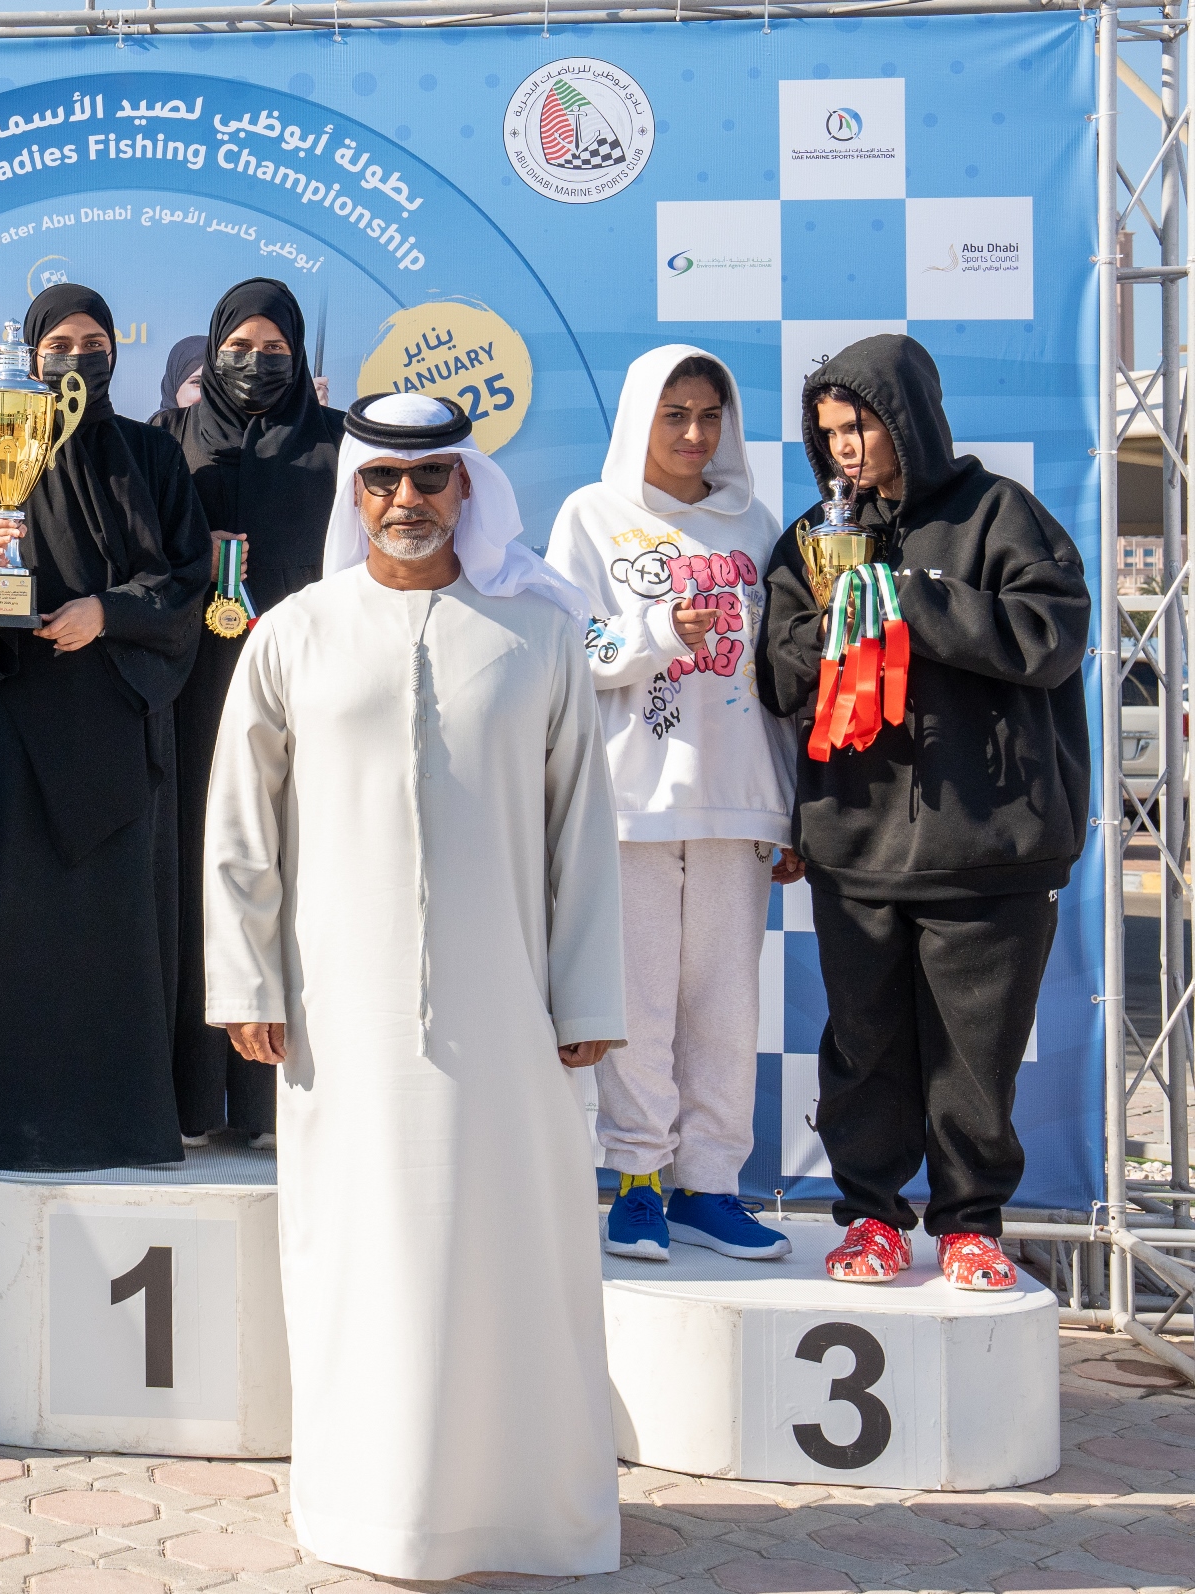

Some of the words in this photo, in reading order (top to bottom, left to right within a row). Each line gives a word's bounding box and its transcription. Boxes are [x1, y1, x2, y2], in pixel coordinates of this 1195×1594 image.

[540, 65, 592, 83] للرياضات
[592, 71, 631, 91] أبوظبي
[115, 96, 204, 126] لصيد
[513, 81, 540, 117] البحرية
[625, 91, 645, 115] نادي
[213, 110, 334, 158] أبوظبي
[334, 137, 424, 218] بطولة
[514, 150, 528, 170] ABU
[526, 167, 553, 191] DHABI
[554, 184, 594, 197] MARINE
[594, 169, 629, 195] SPORTS
[625, 148, 644, 171] CLUB
[41, 213, 76, 231] Abu
[80, 205, 132, 223] Dhabi
[87, 132, 207, 170] Fishing
[216, 142, 426, 271] Championship
[140, 205, 206, 227] الأمواج
[206, 218, 258, 241] كاسر
[259, 238, 325, 273] أبوظبي
[961, 243, 984, 253] Abu
[987, 242, 1019, 253] Dhabi
[961, 254, 988, 264] Sports
[989, 254, 1019, 263] Council
[402, 326, 457, 368] يناير
[392, 340, 495, 394] JANUARY
[447, 372, 515, 423] 25
[610, 528, 650, 547] FEEL
[666, 550, 758, 594] FIND
[652, 707, 681, 740] DAY
[110, 1246, 174, 1388] 1
[792, 1321, 892, 1469] 3
